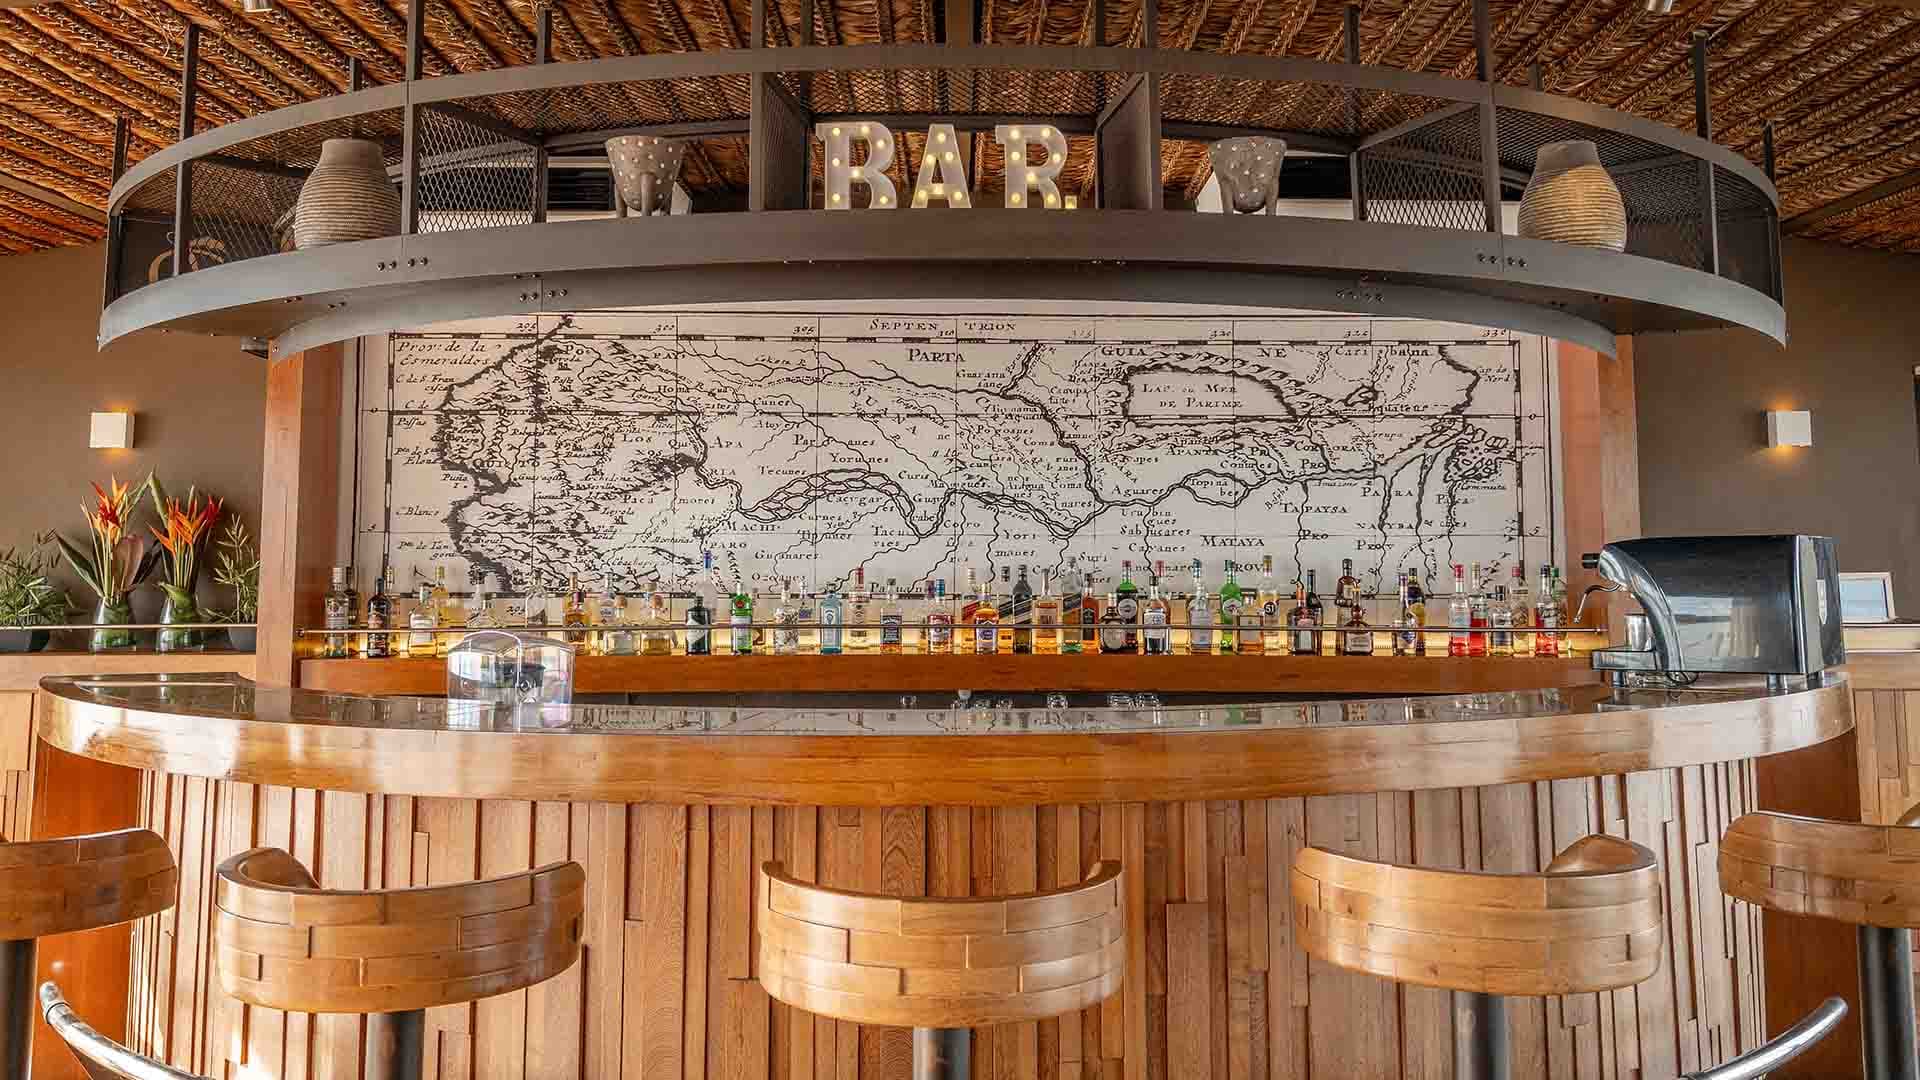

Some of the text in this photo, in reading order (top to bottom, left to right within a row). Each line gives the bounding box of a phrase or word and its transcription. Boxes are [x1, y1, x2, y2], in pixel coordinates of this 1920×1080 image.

[870, 318, 1016, 331] SEPTEN TRION
[443, 340, 460, 352] de
[471, 340, 487, 352] la
[1257, 347, 1288, 358] NE
[1202, 535, 1265, 547] MATAYA
